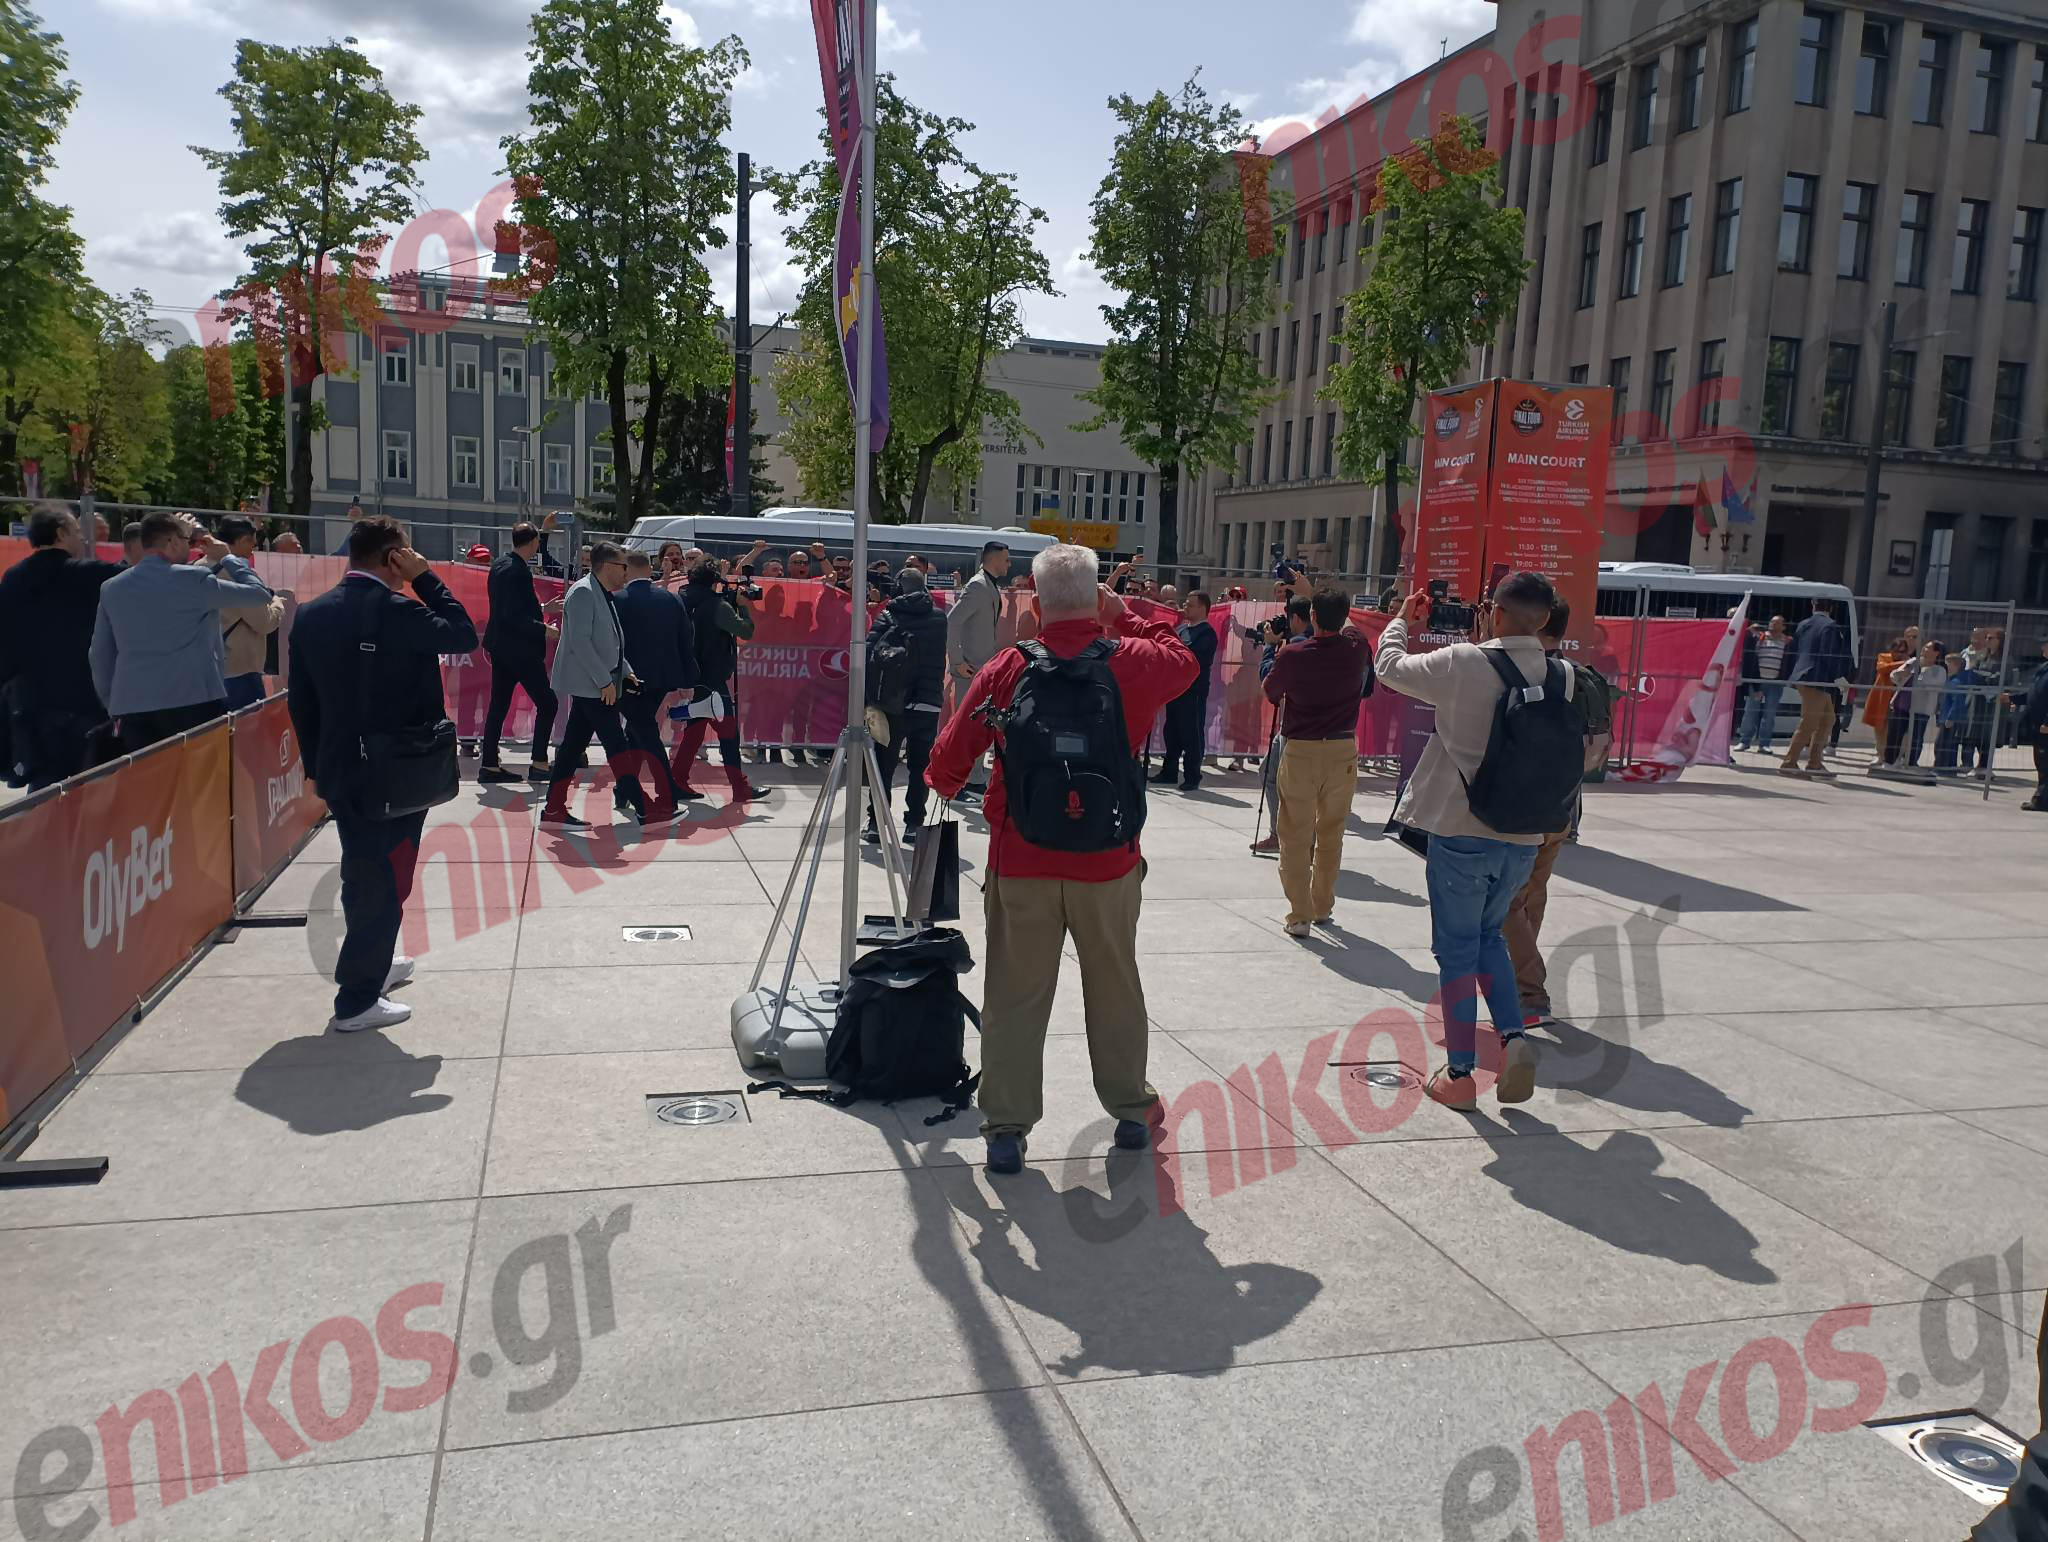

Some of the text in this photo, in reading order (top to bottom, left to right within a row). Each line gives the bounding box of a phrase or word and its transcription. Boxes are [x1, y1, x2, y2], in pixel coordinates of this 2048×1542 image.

[1558, 420, 1590, 428] TURKISH
[1557, 427, 1589, 435] AIRLINES
[1450, 452, 1476, 467] COURT
[1507, 452, 1586, 469] MAIN COURT
[1419, 633, 1447, 645] OTHER
[83, 816, 173, 954] OlyBet
